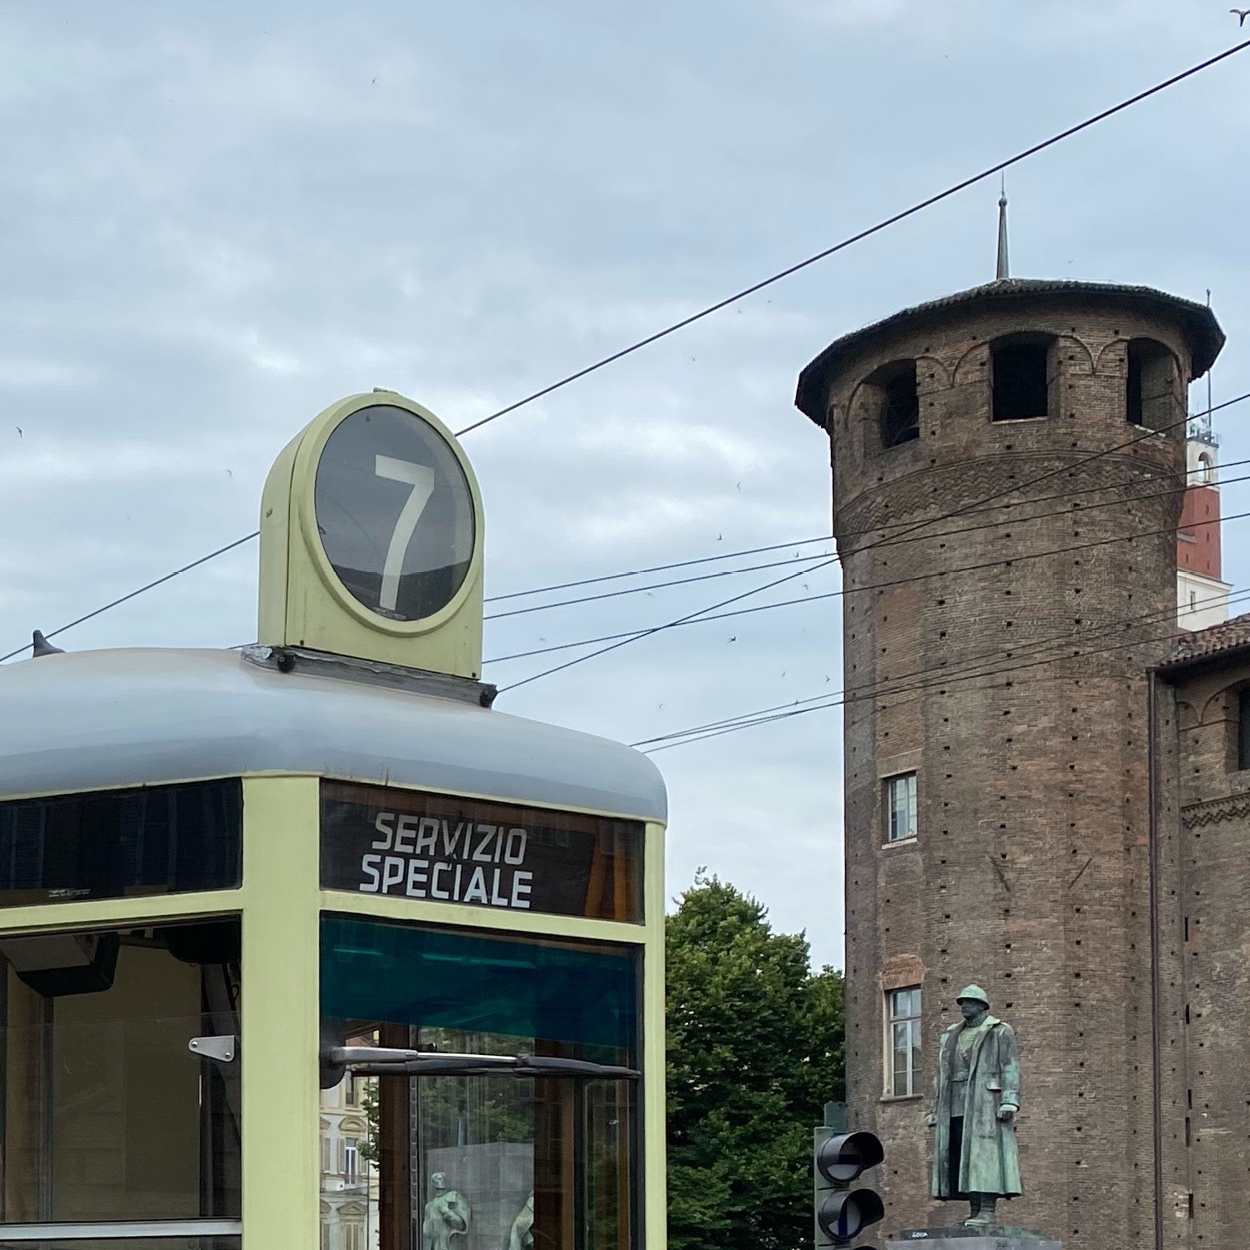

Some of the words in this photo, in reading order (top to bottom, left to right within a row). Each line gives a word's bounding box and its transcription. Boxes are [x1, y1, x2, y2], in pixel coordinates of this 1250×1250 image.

[375, 454, 435, 611] 7
[370, 812, 528, 866] SERVIZIO
[359, 854, 533, 909] SPECIALE
